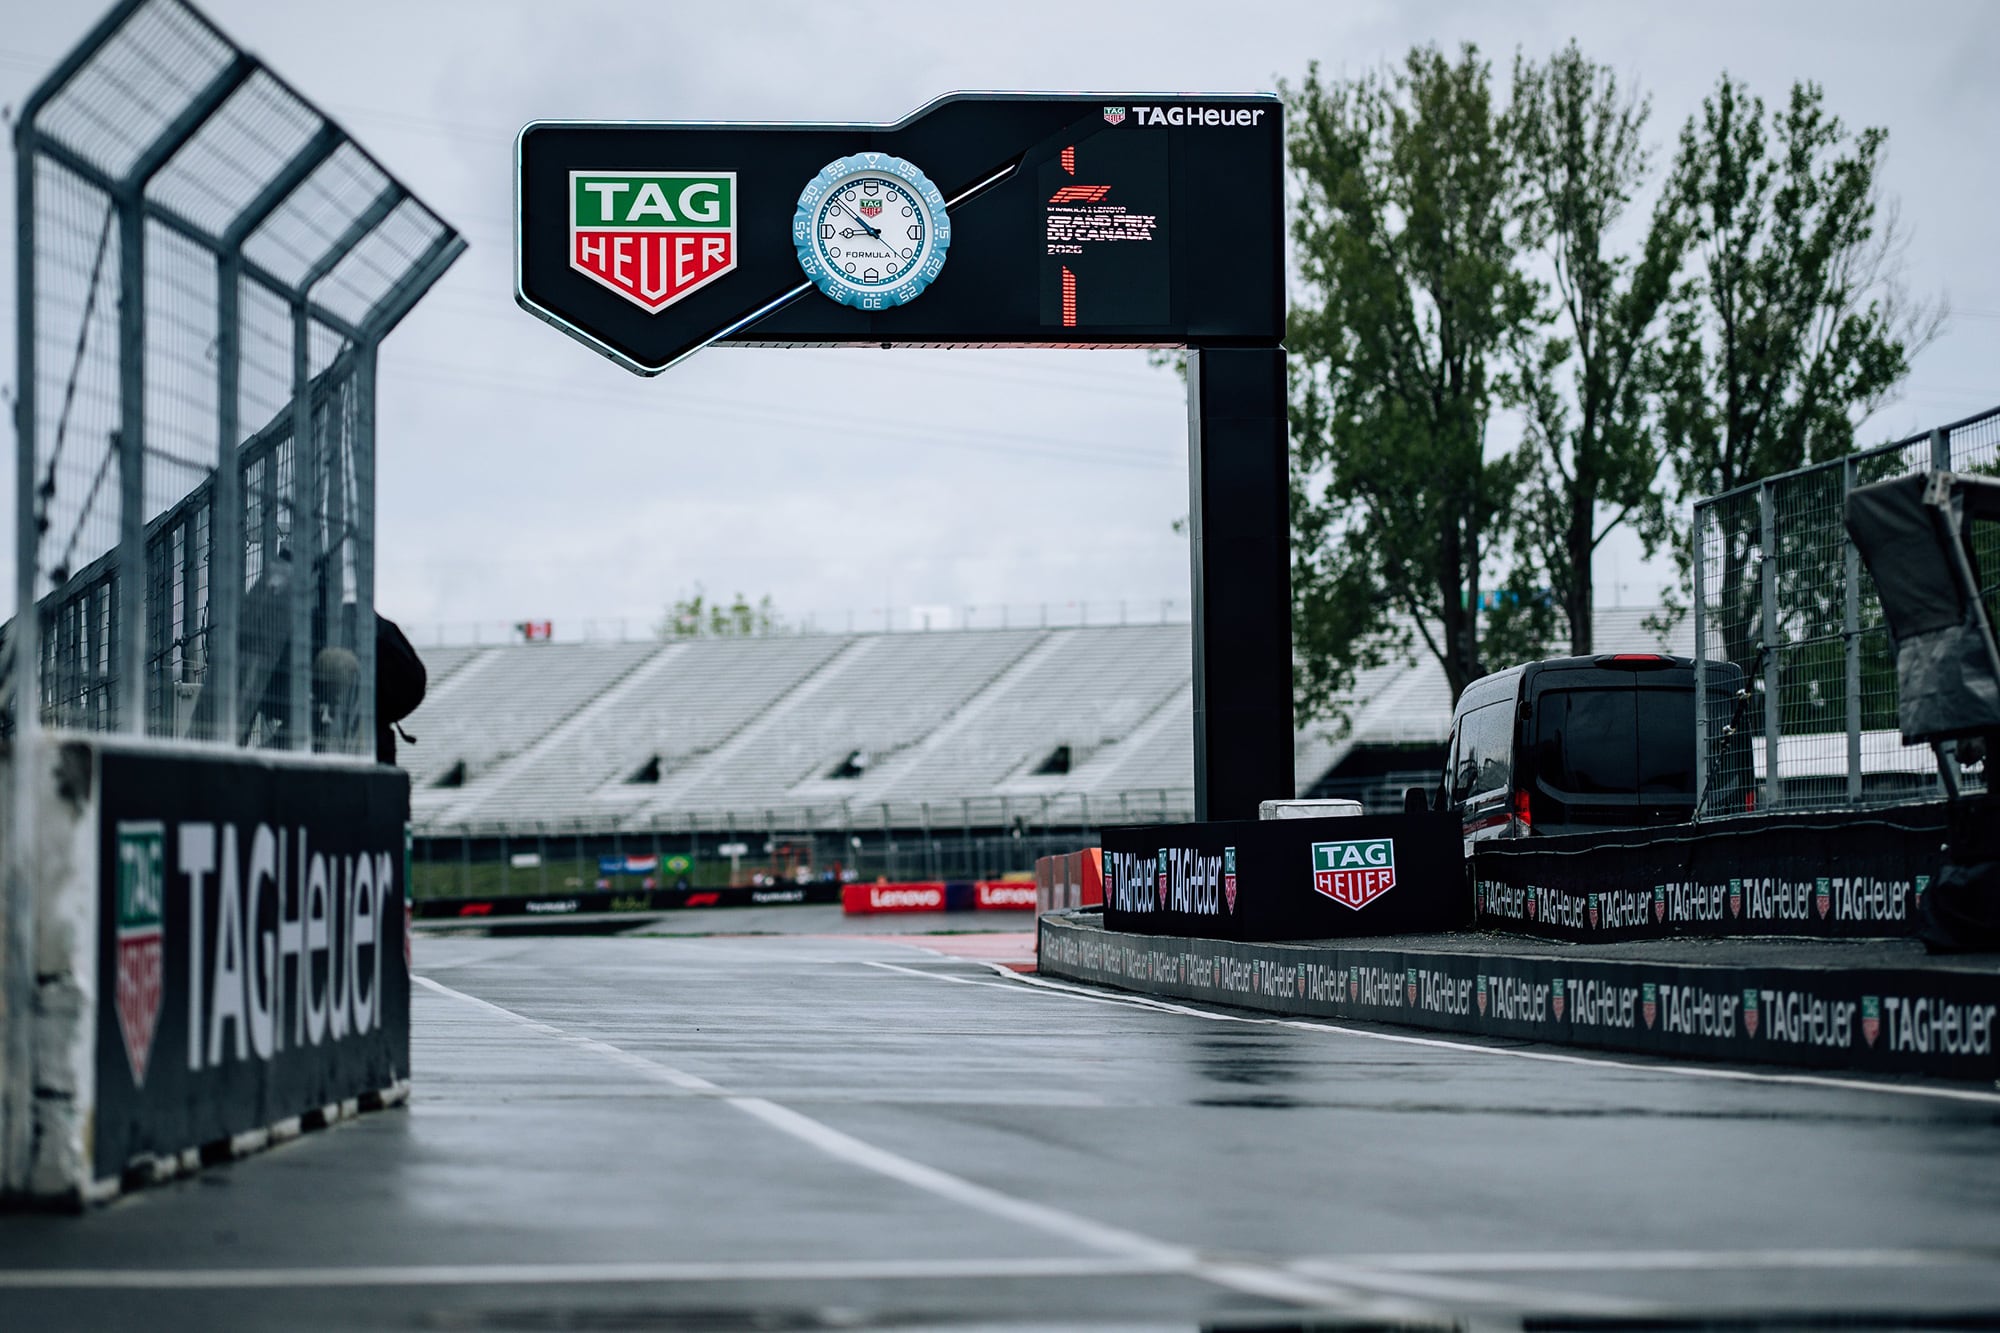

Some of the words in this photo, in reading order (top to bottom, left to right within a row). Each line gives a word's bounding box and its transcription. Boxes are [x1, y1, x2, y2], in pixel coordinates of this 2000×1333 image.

[826, 160, 846, 177] 55
[899, 161, 918, 177] 05
[585, 182, 721, 222] TAG
[802, 186, 818, 204] 50
[929, 189, 941, 204] 10
[1047, 215, 1112, 228] GRAND
[1113, 215, 1157, 228] PRIX
[795, 221, 806, 240] 45
[939, 226, 949, 239] 15
[1047, 228, 1073, 241] DU
[1074, 228, 1153, 241] CANADA
[845, 251, 891, 259] FORMULA
[1047, 244, 1083, 255] 2026
[581, 236, 726, 301] HEUER
[801, 256, 817, 274] 40
[927, 259, 943, 278] 20
[827, 285, 846, 302] 35
[899, 286, 918, 302] 25
[863, 298, 882, 309] 30
[1319, 844, 1387, 867] TAG
[980, 886, 1038, 905] Lenov
[1319, 871, 1391, 904] HEUER
[870, 888, 941, 908] Lenovo
